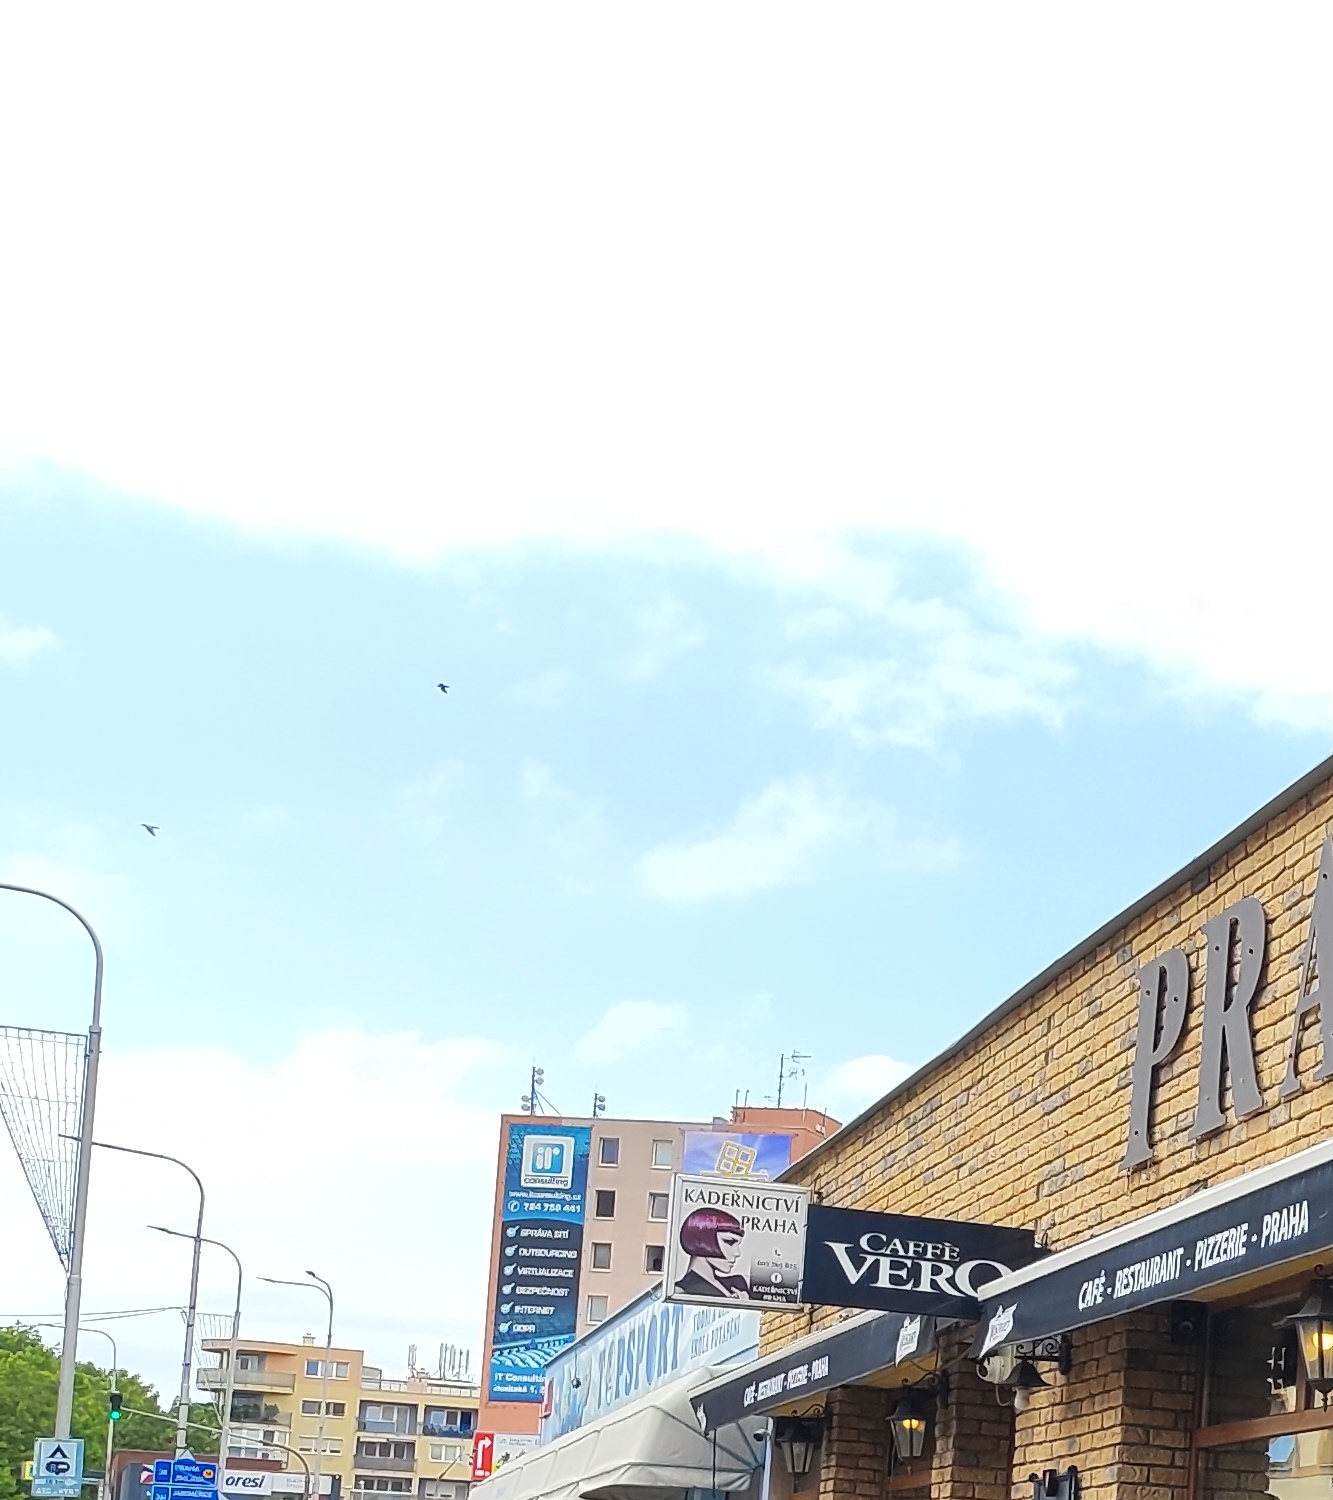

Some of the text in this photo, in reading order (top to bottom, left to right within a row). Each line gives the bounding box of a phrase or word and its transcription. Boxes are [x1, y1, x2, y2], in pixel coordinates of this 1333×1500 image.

[684, 1187, 801, 1213] KADEŘNICTVÍ
[740, 1214, 800, 1235] PRAHA
[518, 1248, 578, 1259] OUTSOURCING
[1078, 1201, 1309, 1312] CAFÉ RESTAURANT PIZZERIE PRAHA
[517, 1266, 574, 1278] VIRTUALIZACE
[823, 1241, 1016, 1298] VERO
[225, 1475, 266, 1488] oresi
